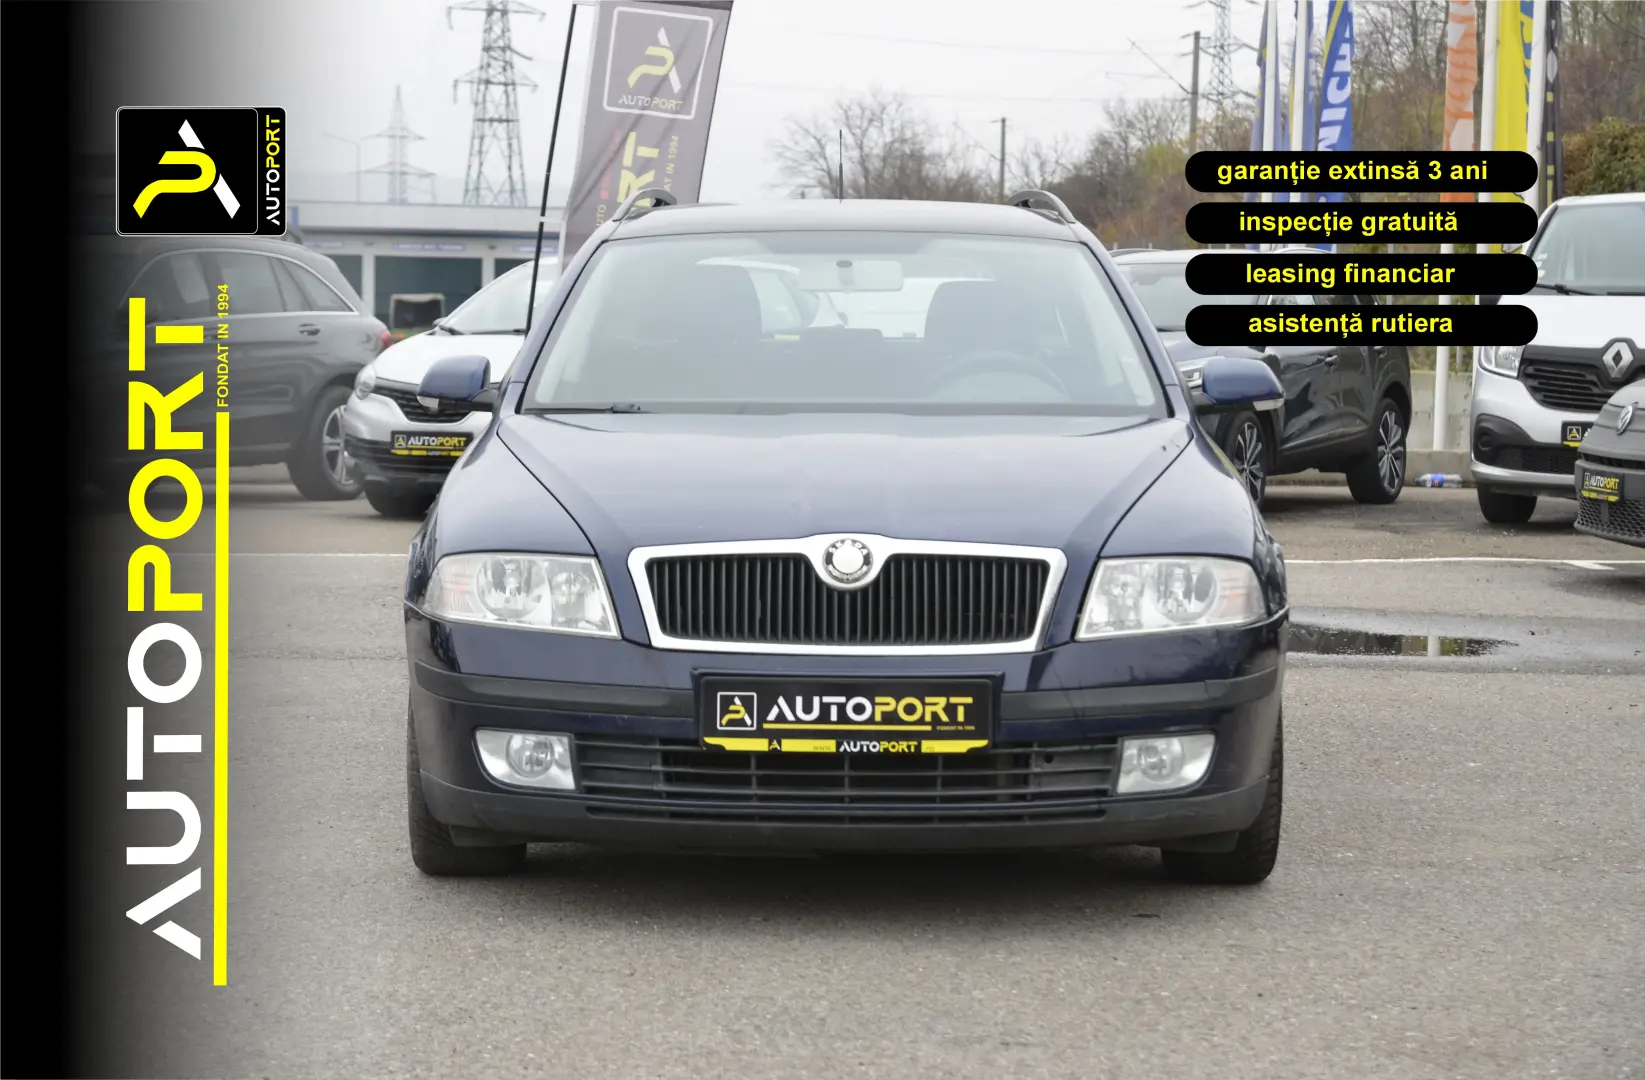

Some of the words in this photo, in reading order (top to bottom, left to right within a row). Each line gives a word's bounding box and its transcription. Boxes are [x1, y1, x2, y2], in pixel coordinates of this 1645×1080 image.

[618, 95, 683, 111] AUTOPORT
[668, 135, 679, 159] 1994
[595, 204, 607, 227] UTO
[408, 436, 466, 446] AUTOPORT
[1590, 475, 1619, 489] AUTOPORT
[766, 695, 973, 722] AUTOPORT
[839, 740, 918, 753] AUTOPORT
